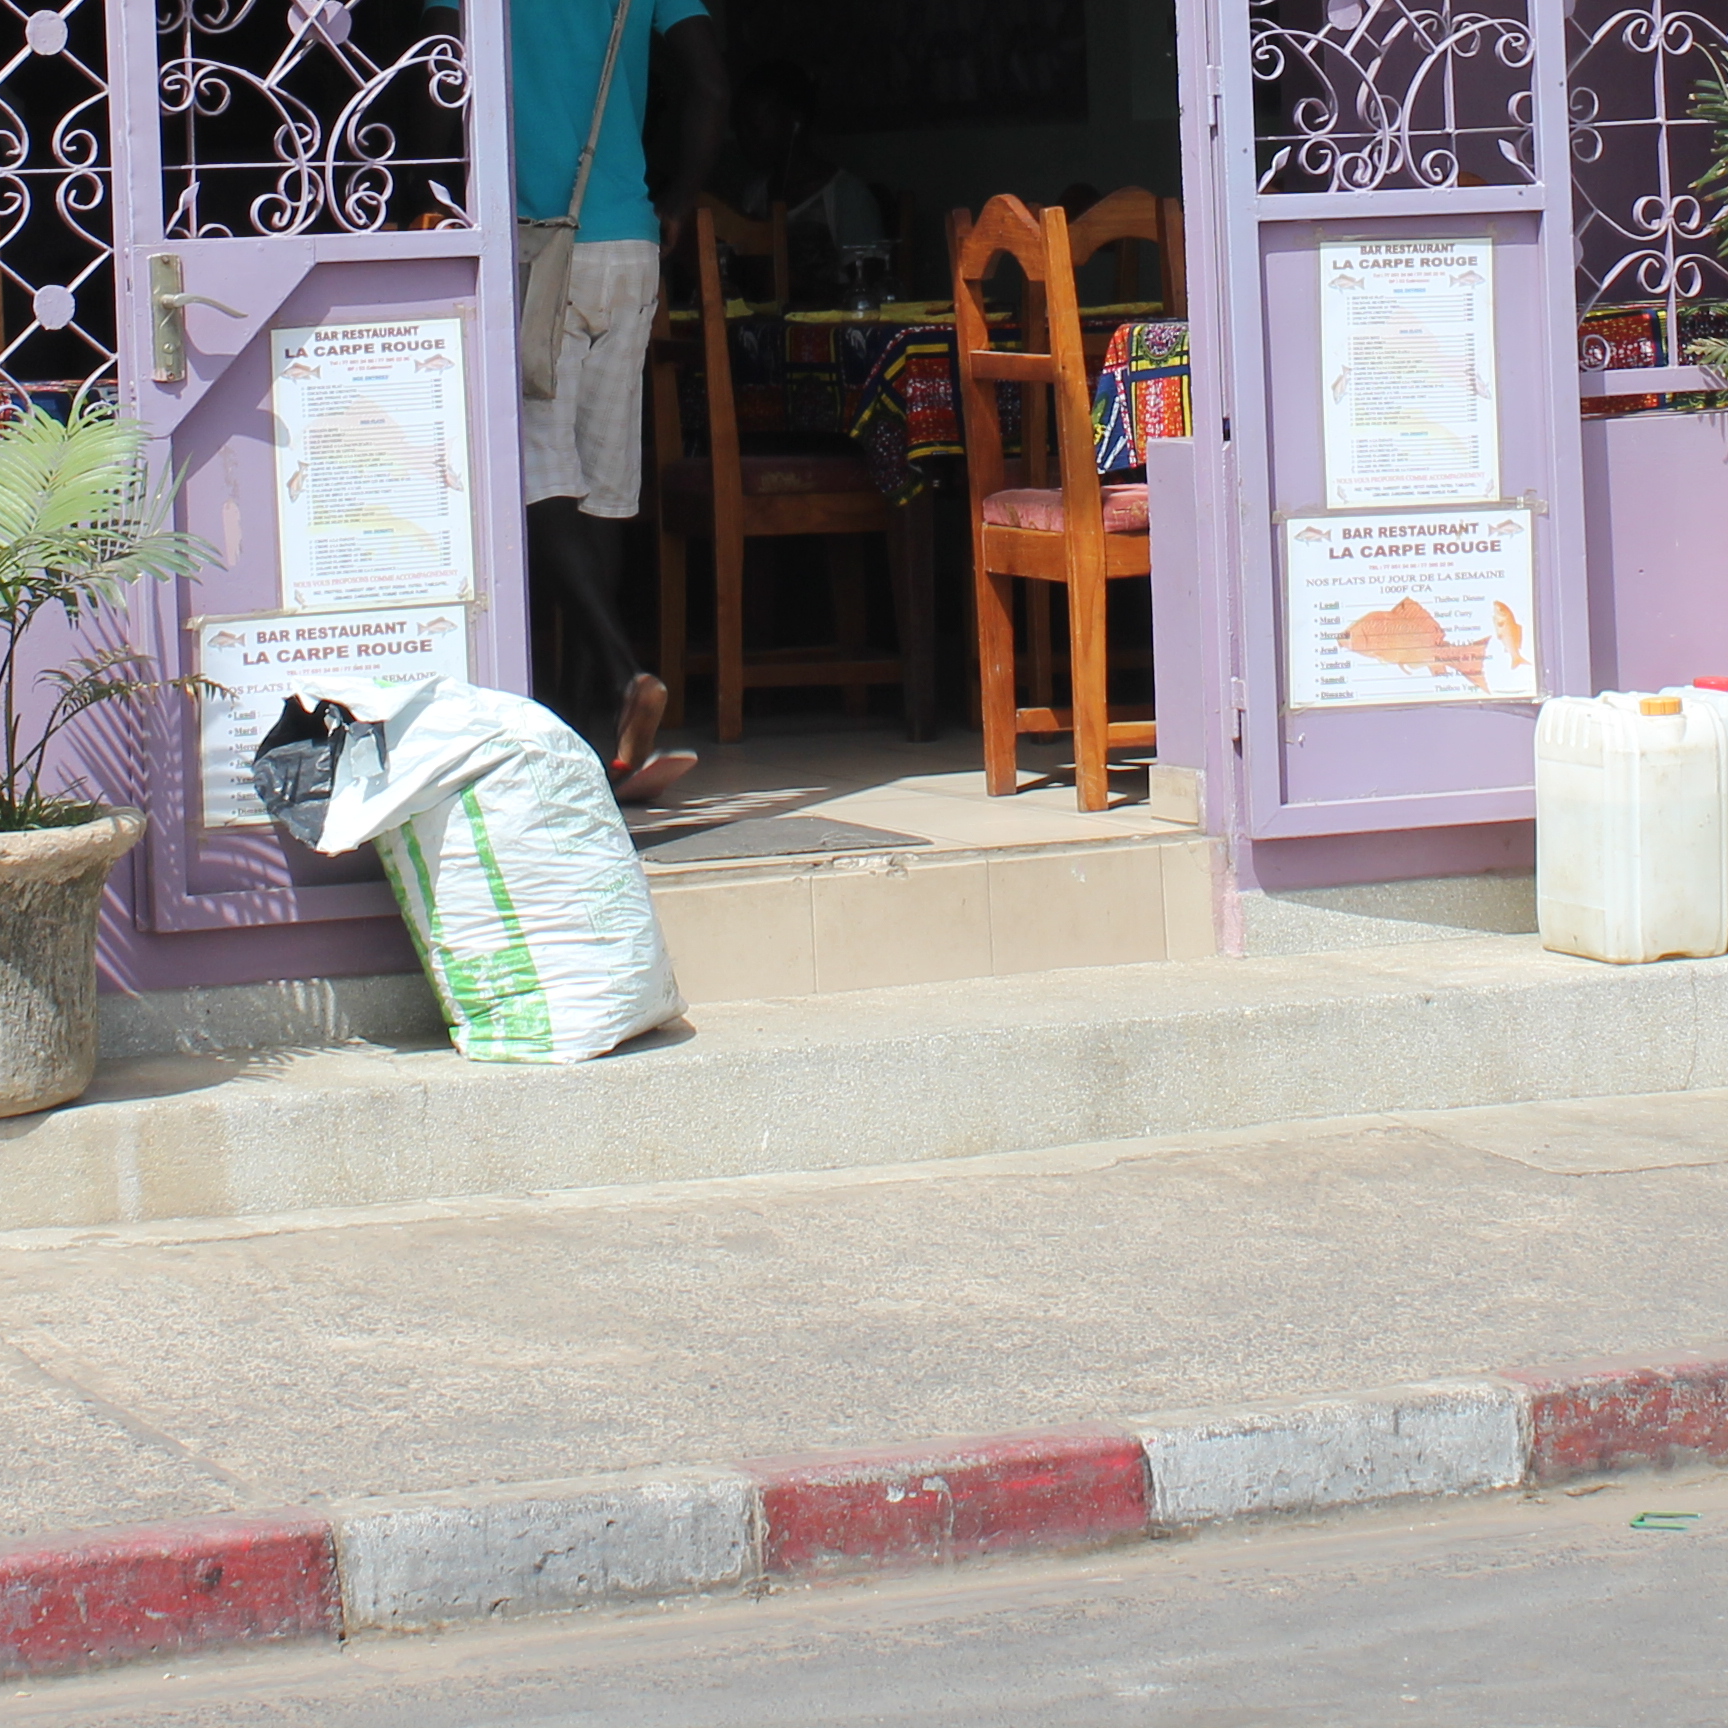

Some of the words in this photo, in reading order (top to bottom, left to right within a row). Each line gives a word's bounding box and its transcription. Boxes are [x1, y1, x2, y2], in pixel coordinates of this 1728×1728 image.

[1360, 245, 1382, 255] BAR
[1384, 243, 1456, 254] RESTAURANT
[1332, 259, 1354, 270] LA
[1358, 257, 1415, 269] CARPE
[1420, 256, 1478, 267] ROUGE
[314, 331, 339, 342] BAR
[341, 325, 420, 340] RESTAURANT
[284, 347, 309, 359] LA
[313, 343, 375, 357] CARPE
[381, 339, 446, 354] ROUGE
[1342, 527, 1373, 540] BAR
[1378, 522, 1479, 538] RESTAURANT
[1328, 547, 1354, 560] LA
[1360, 543, 1427, 558] CARPE
[1432, 539, 1502, 555] ROUGE
[1306, 578, 1329, 587] NOS
[1332, 576, 1366, 586] PLATS
[1368, 575, 1386, 584] DU
[1388, 574, 1418, 583] JOUR
[1420, 573, 1435, 582] DE
[1437, 572, 1453, 581] LA
[1454, 570, 1506, 581] SEMAINE
[1379, 585, 1409, 594] 1000F
[1411, 584, 1433, 593] CFA
[256, 631, 290, 645] BAR
[295, 621, 408, 642] RESTAURANT
[242, 652, 270, 666] LA
[277, 645, 350, 664] CARPE
[357, 638, 434, 658] ROUGE
[246, 683, 284, 694] PLATS
[235, 743, 260, 752] Mercr
